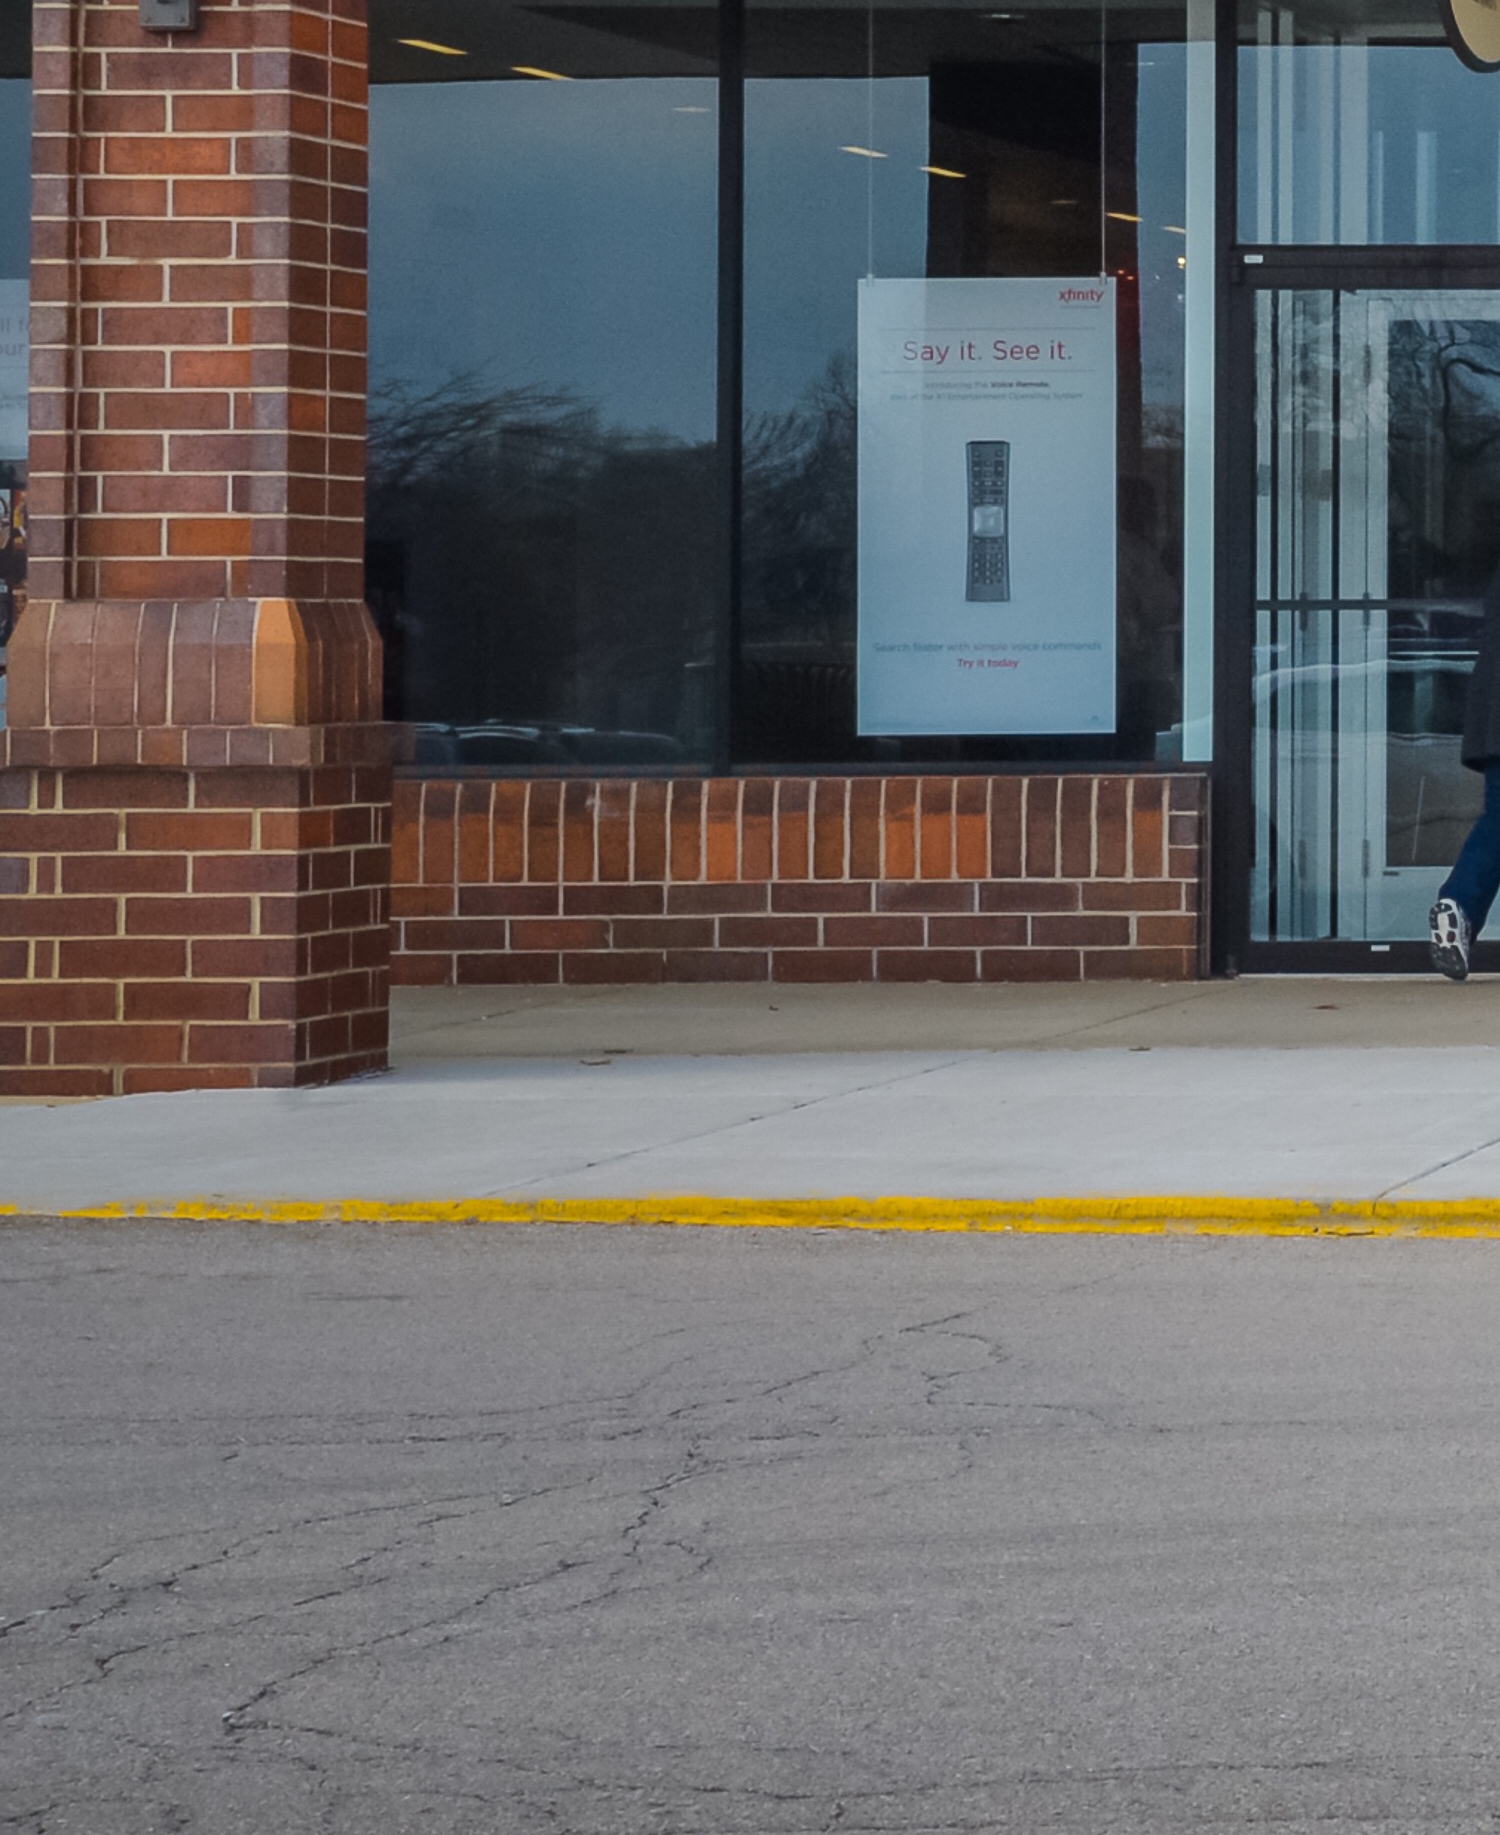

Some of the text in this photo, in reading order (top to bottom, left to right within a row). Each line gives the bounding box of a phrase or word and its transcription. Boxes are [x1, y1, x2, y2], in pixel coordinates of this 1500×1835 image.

[1058, 288, 1104, 304] xfinity
[903, 340, 1073, 364] Say it. See it.
[957, 658, 1020, 669] Try it today
